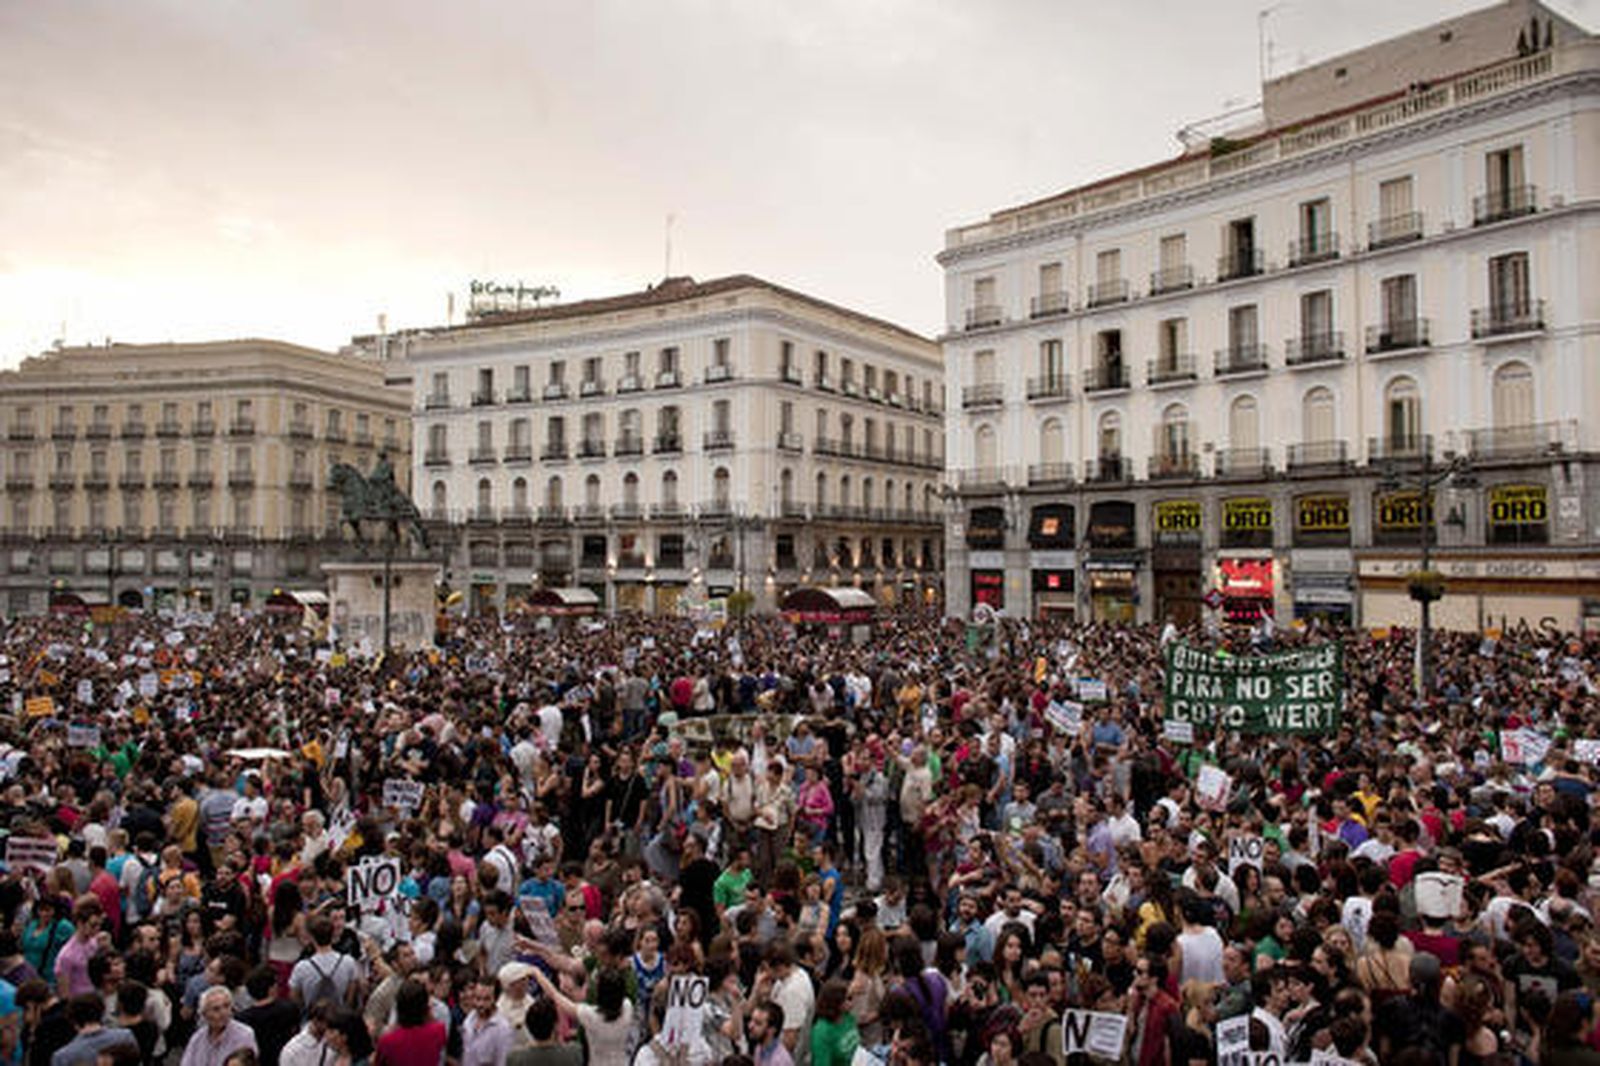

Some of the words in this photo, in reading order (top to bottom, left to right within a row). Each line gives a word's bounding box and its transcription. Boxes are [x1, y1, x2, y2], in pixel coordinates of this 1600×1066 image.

[1226, 510, 1271, 527] ORO
[1301, 507, 1348, 526] ORO
[1380, 503, 1432, 523] ORO
[1493, 500, 1546, 520] ORO
[1158, 513, 1200, 529] ORO
[1171, 671, 1223, 698] PARA
[1236, 676, 1271, 699] NO
[1285, 671, 1334, 699] SER
[1264, 702, 1335, 728] WERT
[1231, 839, 1263, 859] NO
[351, 863, 396, 902] NO
[671, 979, 706, 1008] NO
